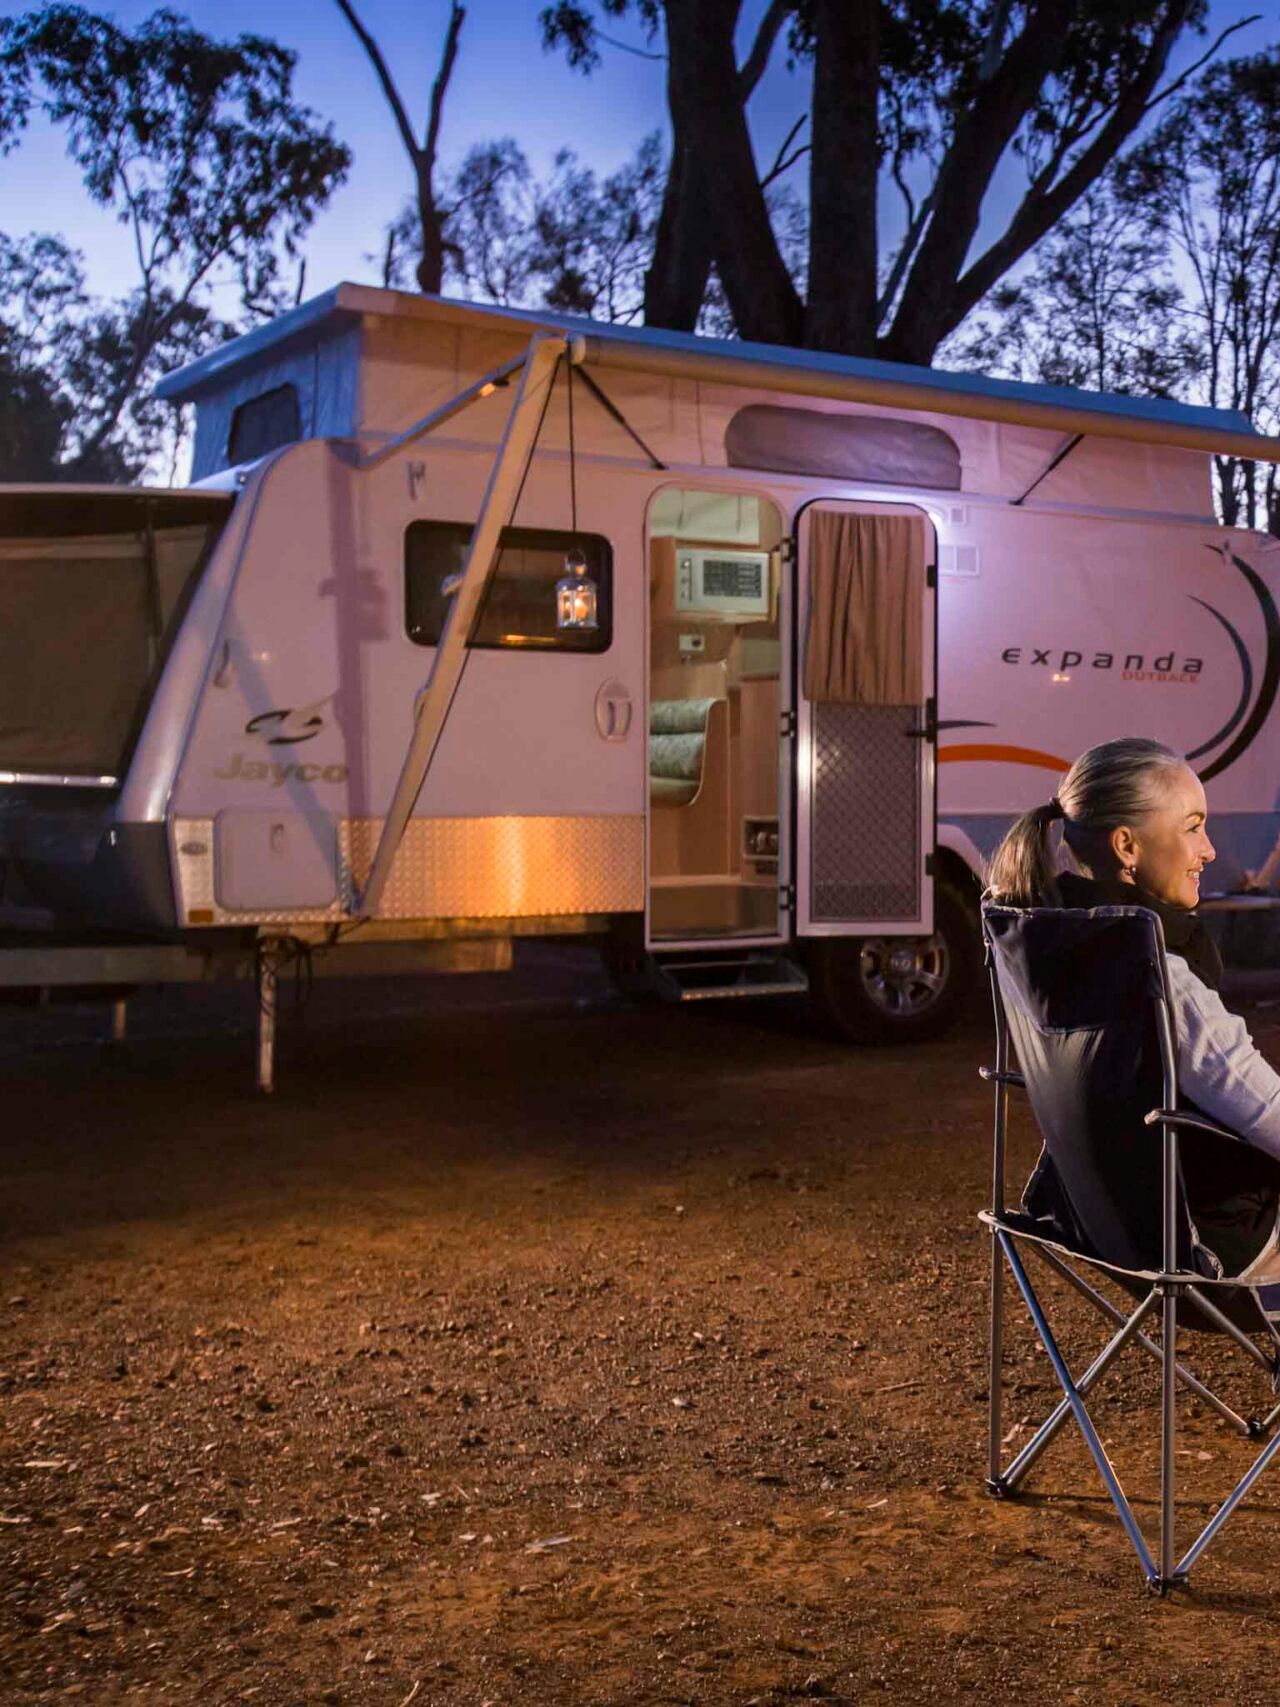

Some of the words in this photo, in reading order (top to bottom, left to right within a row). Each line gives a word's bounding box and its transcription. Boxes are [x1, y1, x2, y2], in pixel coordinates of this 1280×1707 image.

[1001, 647, 1204, 673] expanda
[1121, 671, 1201, 682] OUTBACK
[212, 752, 350, 787] Jayco
